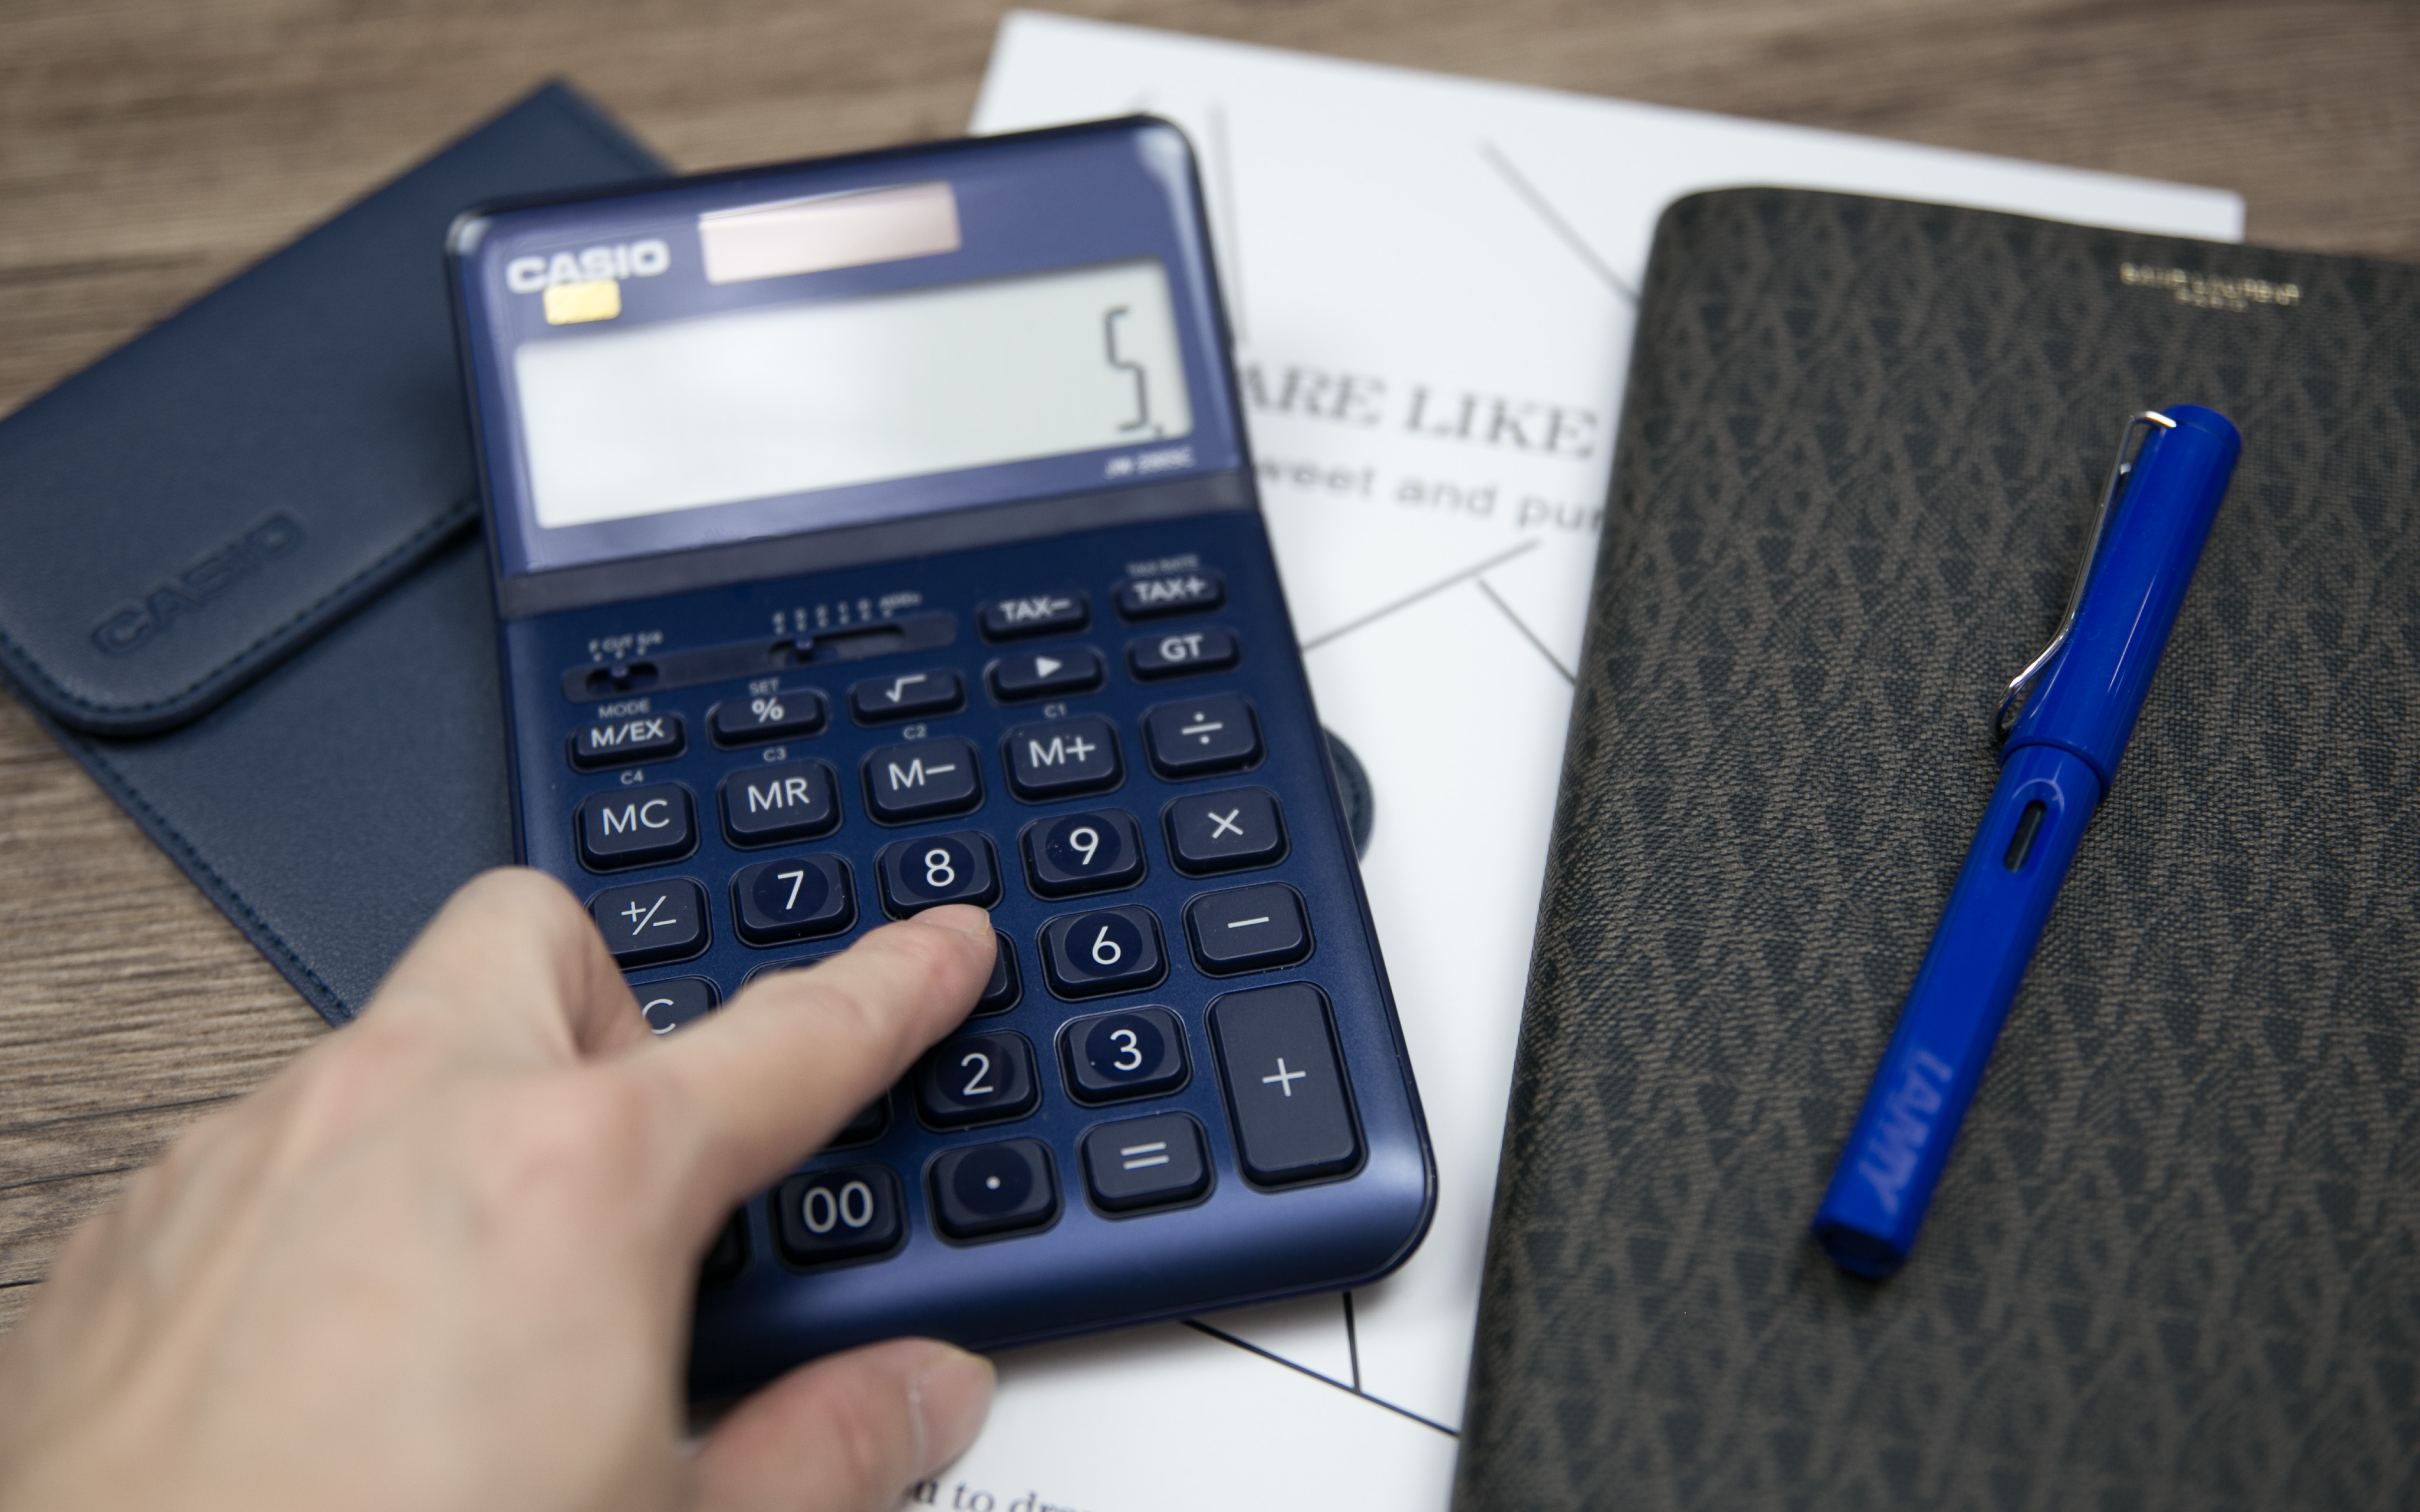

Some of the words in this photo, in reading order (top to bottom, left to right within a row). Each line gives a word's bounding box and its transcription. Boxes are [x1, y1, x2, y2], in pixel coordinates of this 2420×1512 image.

[505, 238, 671, 295] CASIO
[1405, 384, 1600, 463] LIKE
[1395, 476, 1498, 519] and
[1131, 574, 1207, 604] TAX+
[1160, 634, 1202, 661] GT
[749, 678, 781, 696] SET
[599, 699, 651, 719] MODE
[751, 697, 784, 723] %
[1043, 704, 1068, 720] C1
[591, 719, 664, 747] M/EX
[901, 724, 928, 741] C2
[762, 747, 787, 763] C3
[1029, 736, 1096, 767] M+
[619, 770, 645, 786] C4
[748, 778, 810, 813] MR
[603, 799, 670, 835] MC
[1070, 827, 1099, 865] 9
[925, 849, 955, 887] 8
[777, 870, 804, 910] 7
[1092, 925, 1121, 965] 6
[1110, 1029, 1142, 1070] 3
[961, 1053, 994, 1095] 2
[804, 1181, 873, 1233] 00
[952, 1481, 995, 1512] to
